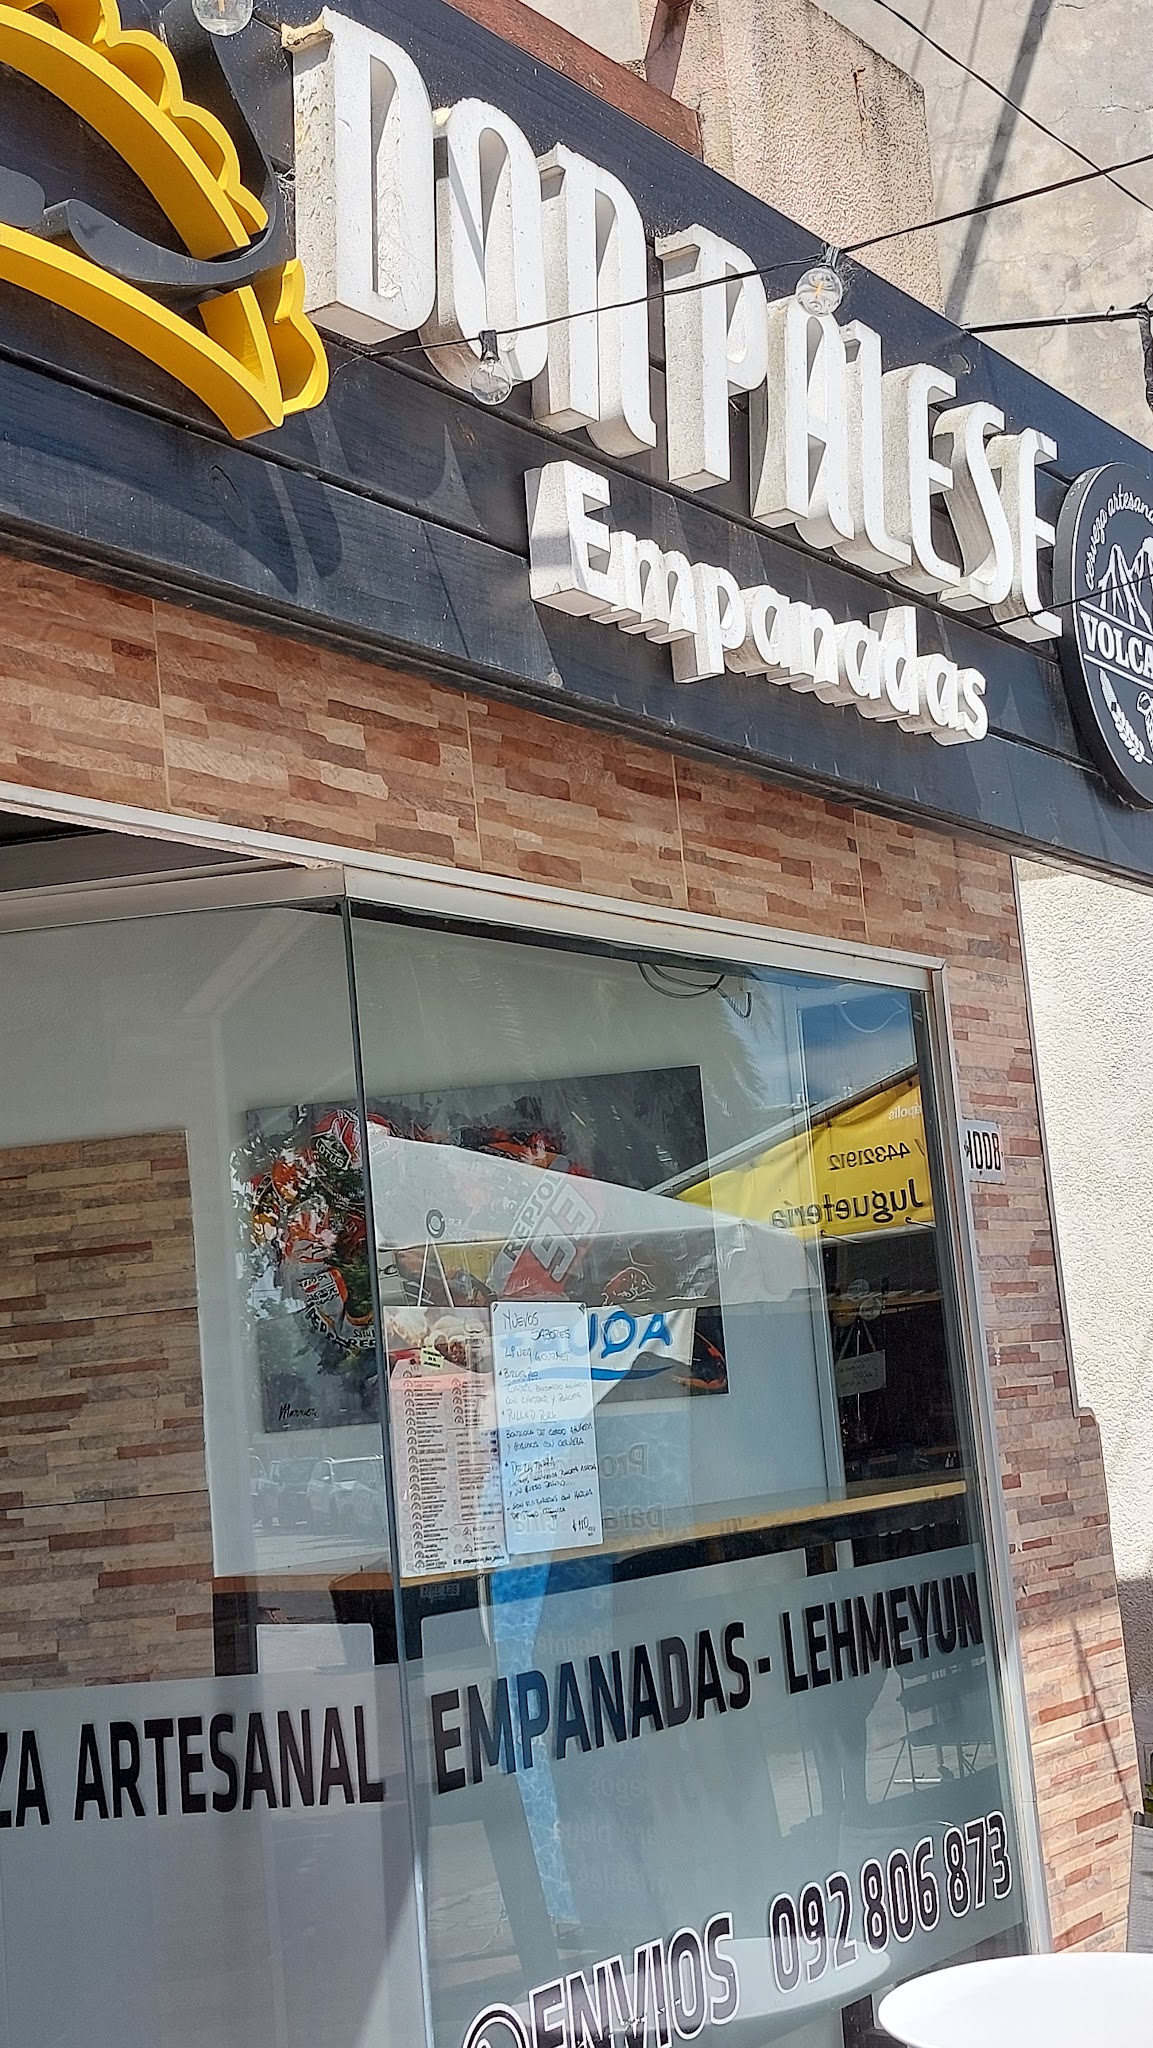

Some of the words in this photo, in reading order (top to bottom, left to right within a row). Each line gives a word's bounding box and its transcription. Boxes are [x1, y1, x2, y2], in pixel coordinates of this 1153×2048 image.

[281, 6, 656, 458] DON
[656, 223, 1063, 643] PALESE
[525, 460, 988, 747] Empanadas
[503, 1173, 564, 1262] REPSOL
[967, 1130, 1001, 1170] 1008
[74, 1704, 386, 1821] ARTESANAL
[780, 1571, 984, 1696] LEHMEYUN
[528, 1911, 741, 2048] ENVIOS
[768, 1870, 859, 1995] 092
[859, 1837, 942, 1957] 806
[942, 1810, 1013, 1918] 873
